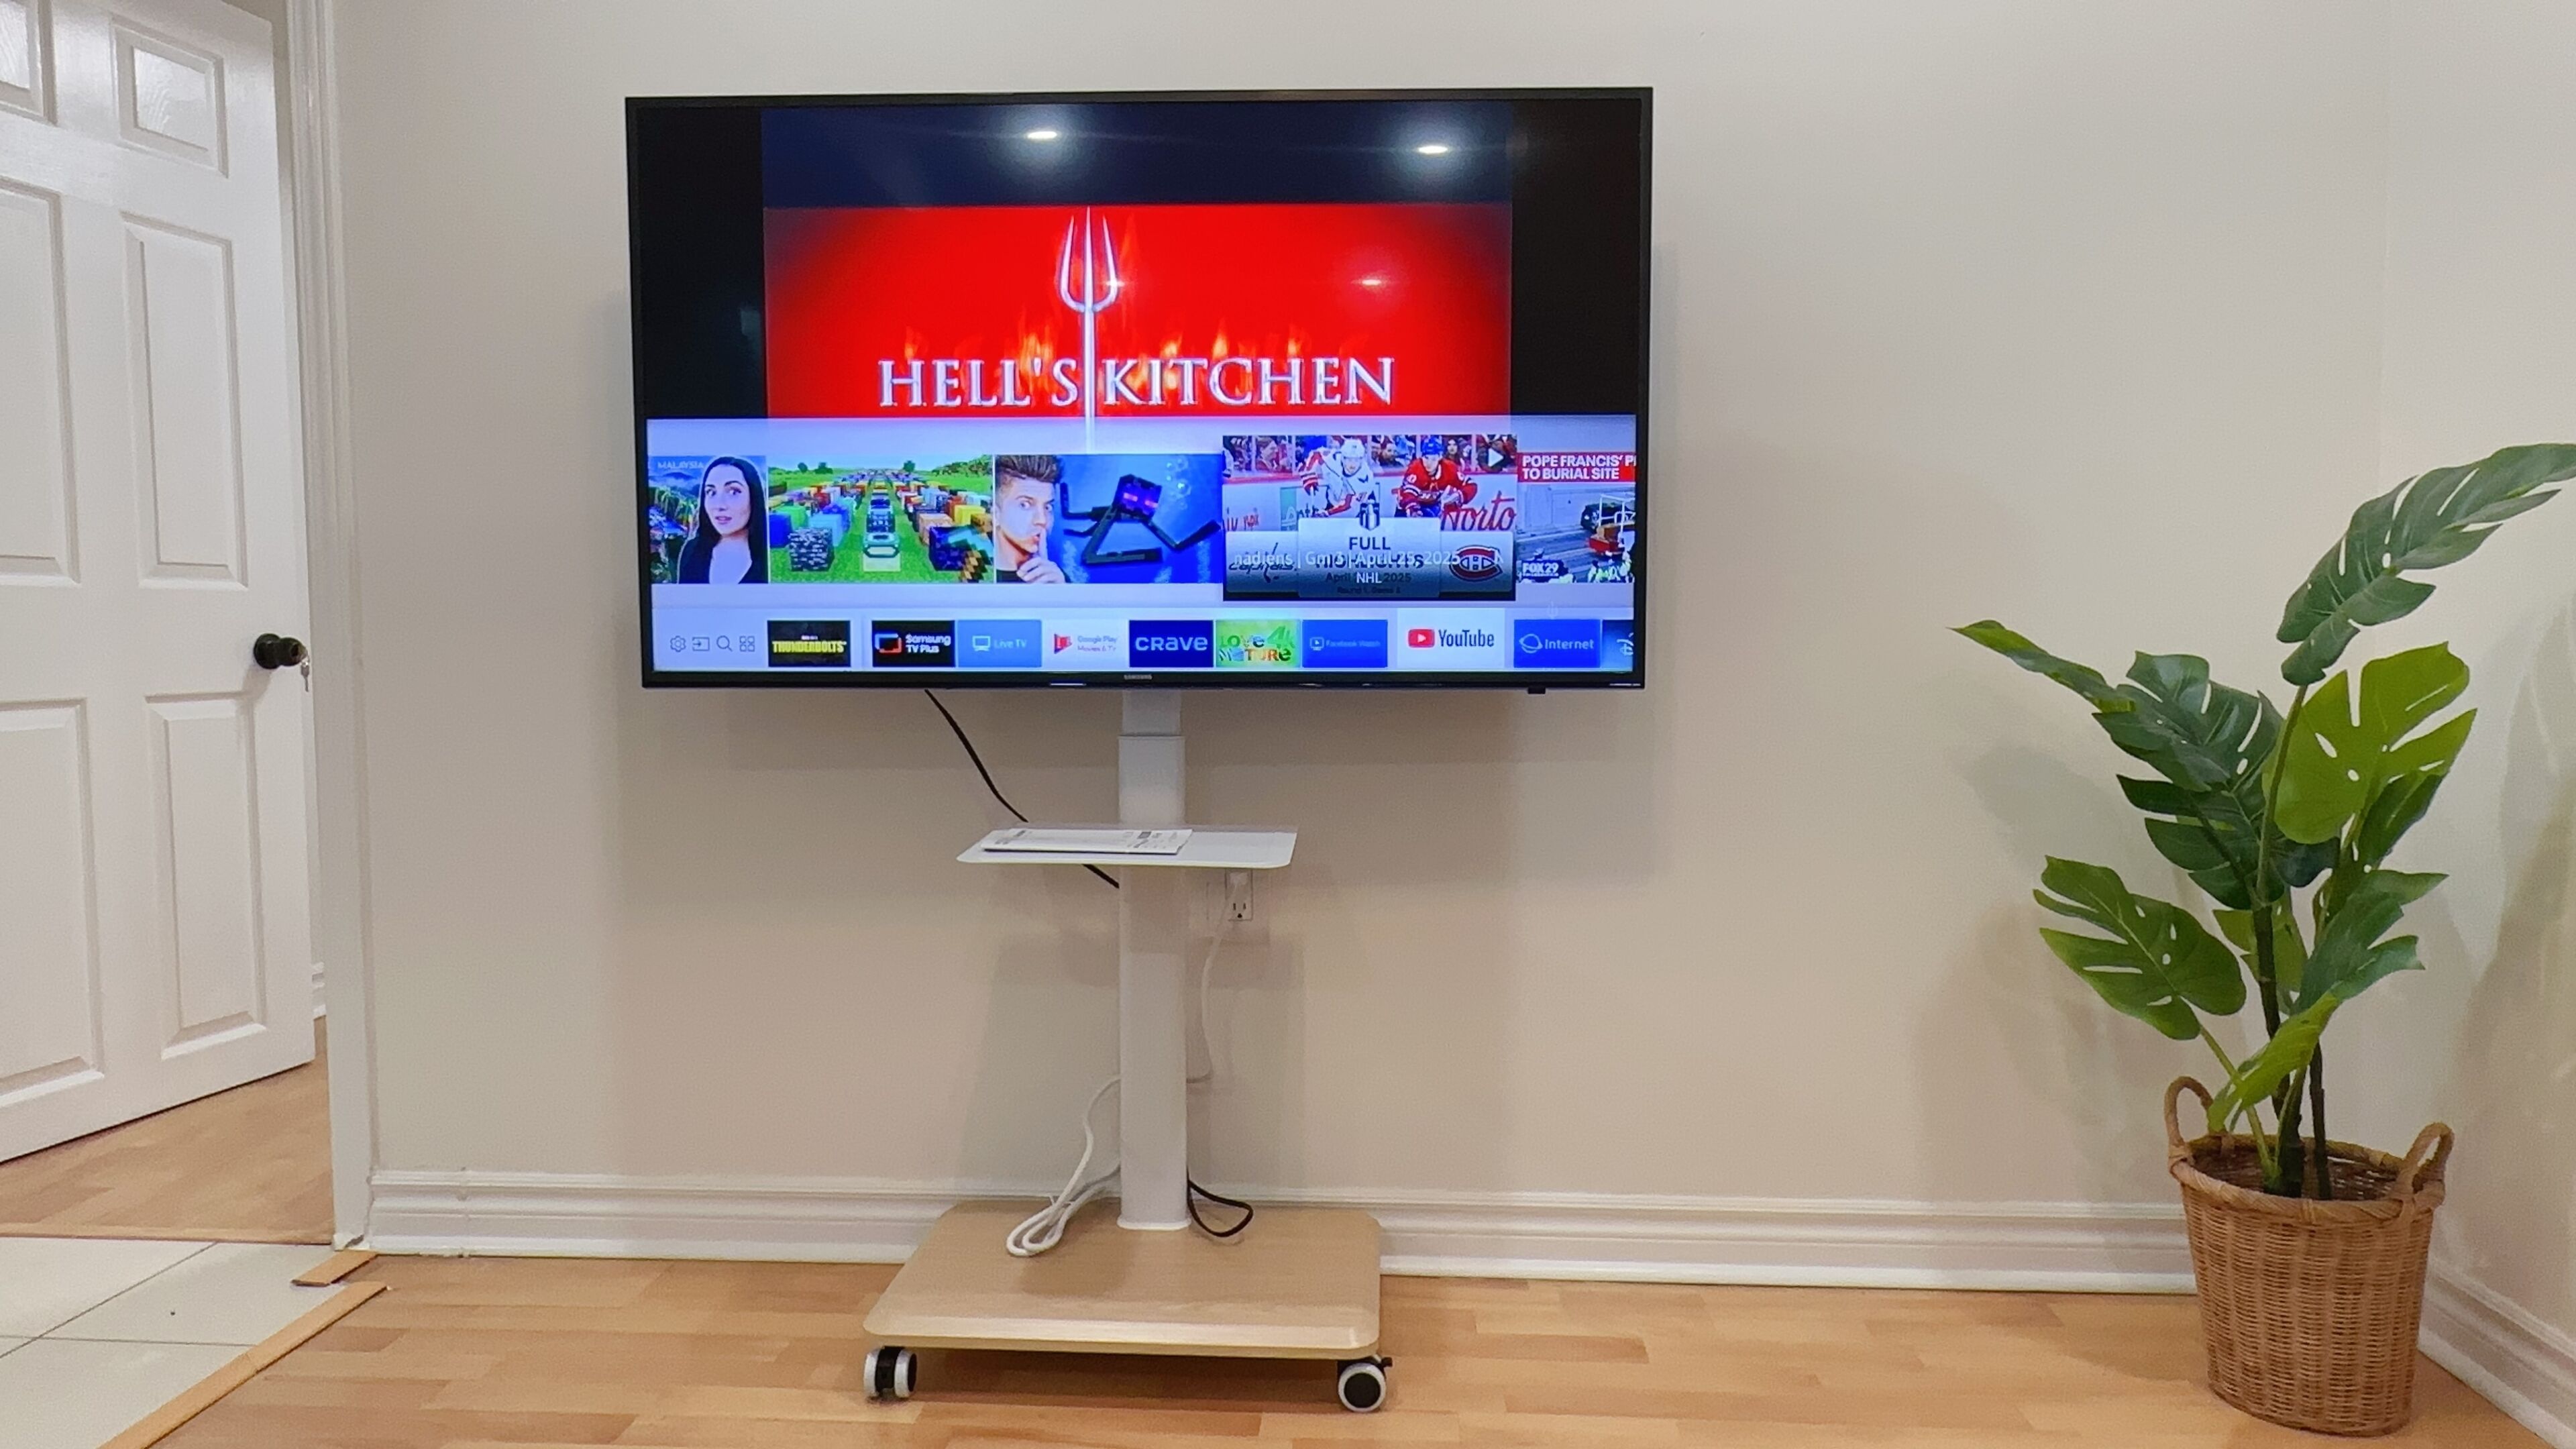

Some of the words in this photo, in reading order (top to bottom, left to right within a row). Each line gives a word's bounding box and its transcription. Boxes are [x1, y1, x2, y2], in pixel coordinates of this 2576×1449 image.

[878, 357, 1079, 407] HELL'S
[1102, 356, 1395, 407] KITCHEN
[657, 460, 704, 470] MALAYSIA
[1522, 455, 1558, 468] POPE
[1560, 455, 1623, 468] FRANCIS'
[1625, 455, 1637, 467] P
[1522, 468, 1541, 480] TO
[1542, 468, 1590, 480] BURIAL
[1591, 468, 1619, 480] SITE
[1348, 537, 1391, 550] FULL
[1424, 550, 1461, 566] 2025
[1356, 571, 1383, 584] NHL
[906, 634, 951, 646] Samsung
[994, 639, 1014, 649] Live
[1015, 639, 1028, 648] TV
[1438, 629, 1495, 648] YouTube
[1544, 639, 1595, 650] Internet
[906, 644, 920, 653] TV
[920, 644, 940, 653] Plus
